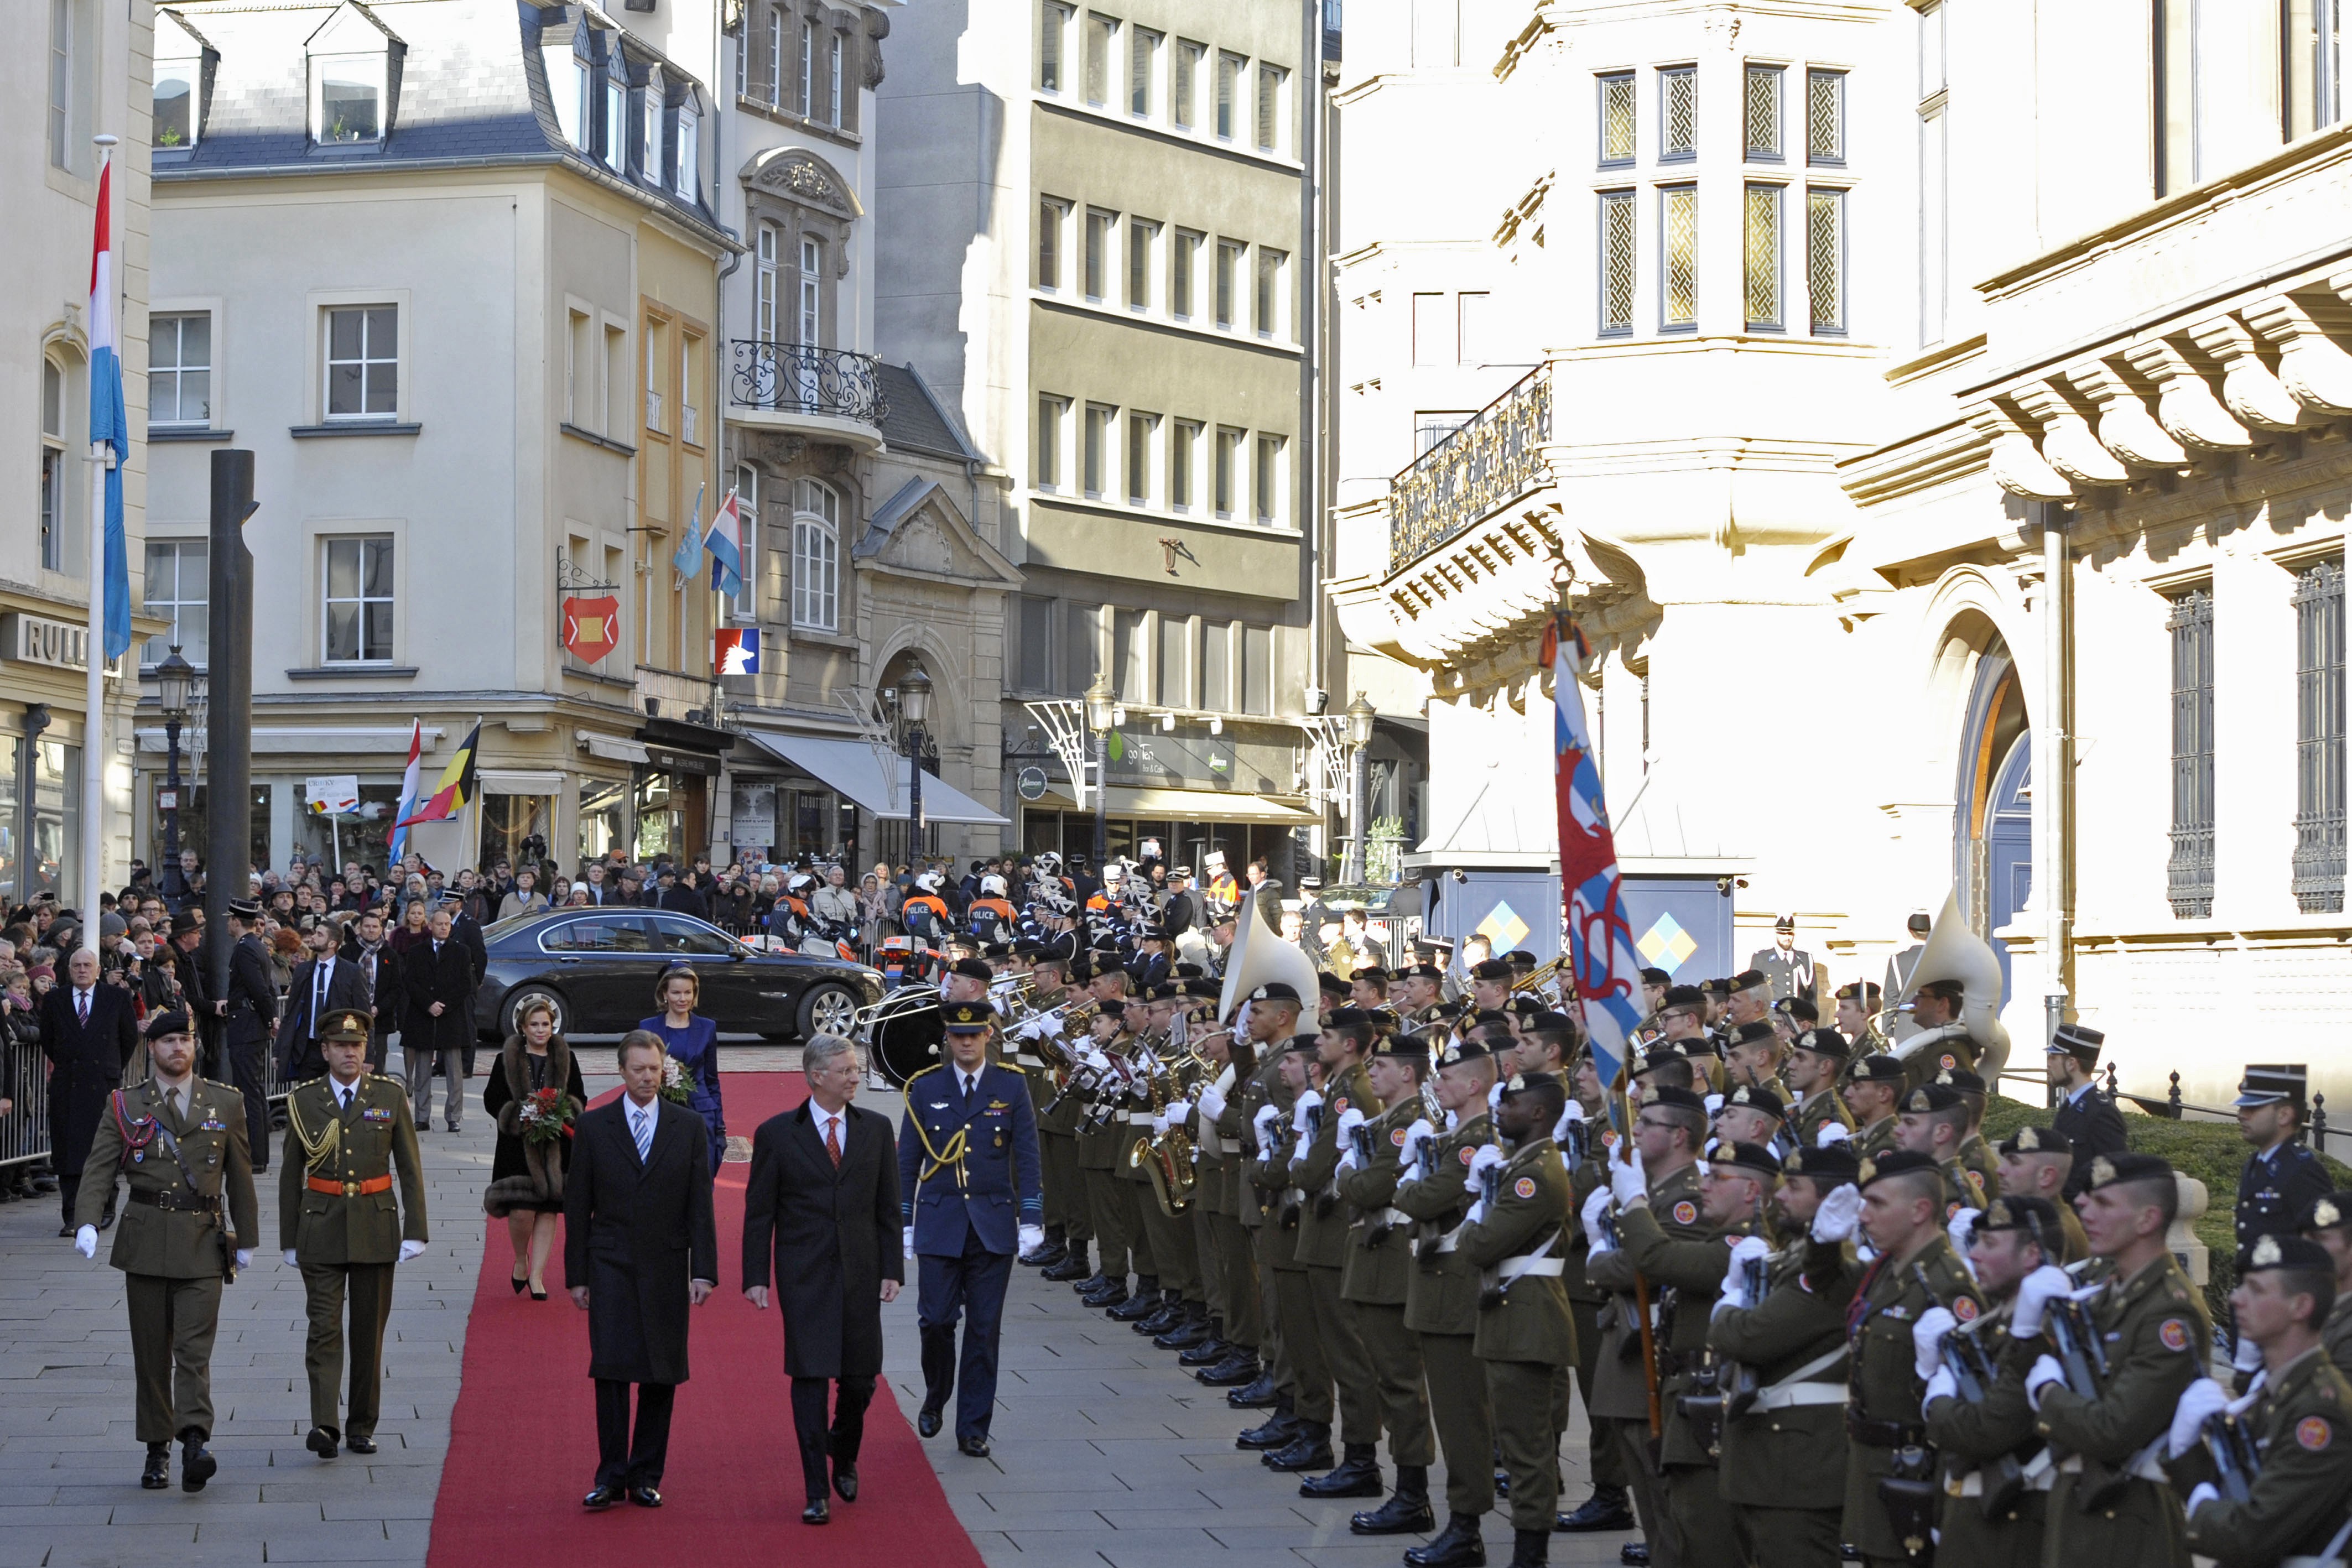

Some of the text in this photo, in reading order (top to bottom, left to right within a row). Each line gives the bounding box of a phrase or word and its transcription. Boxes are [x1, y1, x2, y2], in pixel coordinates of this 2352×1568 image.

[25, 621, 119, 672] RULL
[1128, 749, 1138, 764] go
[907, 905, 928, 914] POLICE
[972, 911, 994, 919] POLICE
